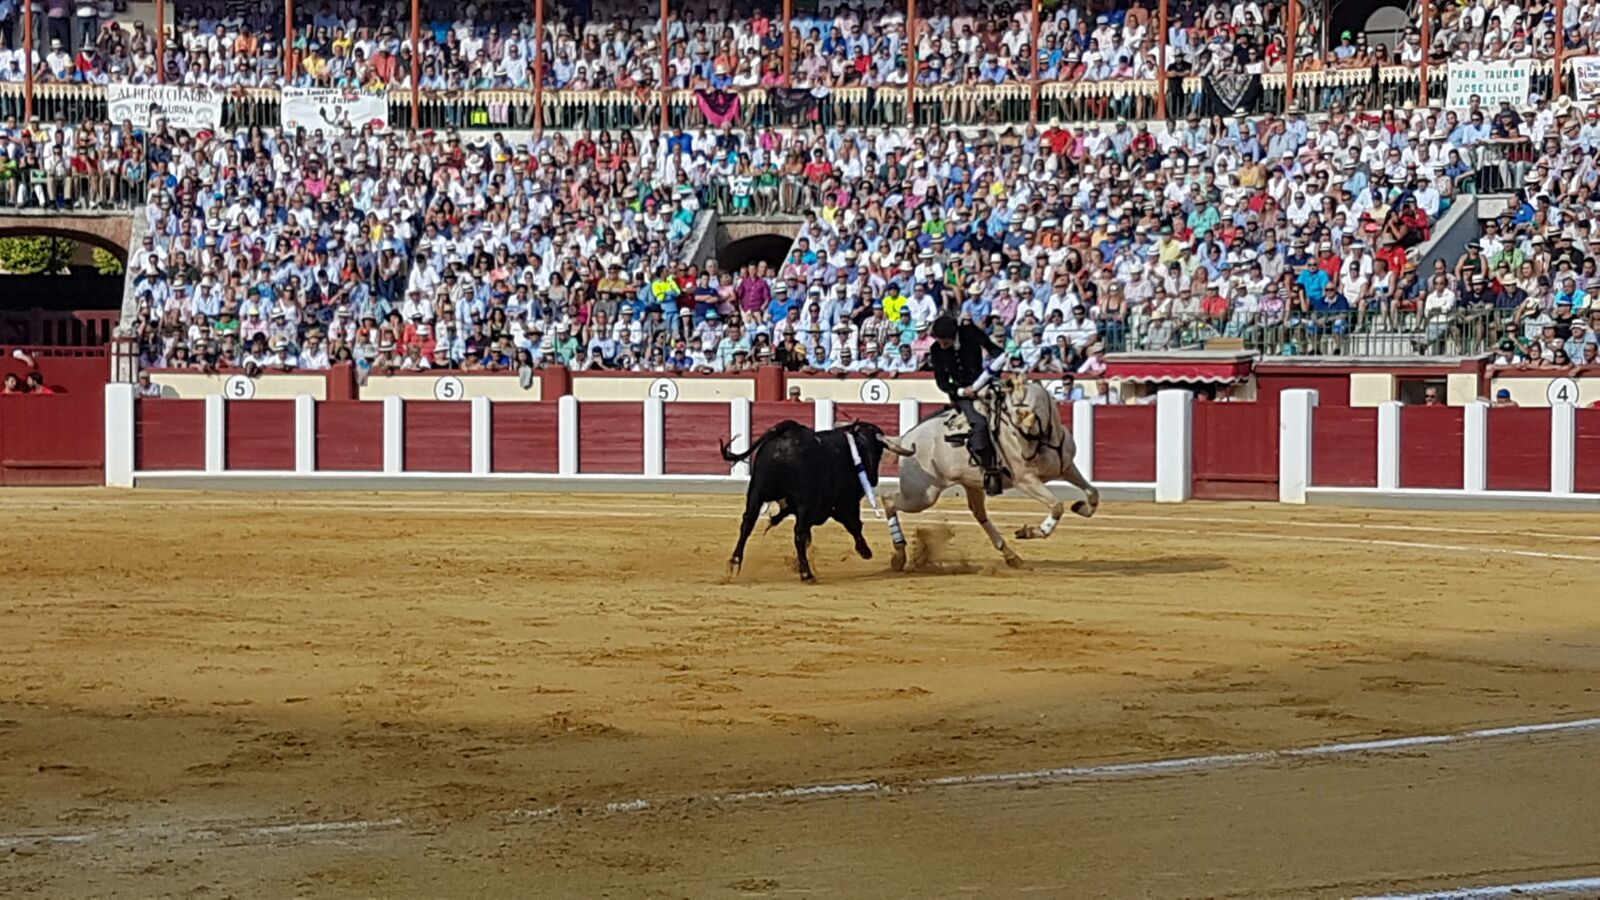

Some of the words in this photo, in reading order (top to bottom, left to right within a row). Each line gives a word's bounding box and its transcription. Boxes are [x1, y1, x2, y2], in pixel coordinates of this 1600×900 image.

[1456, 83, 1519, 93] JOSELILLO
[234, 381, 245, 397] 5
[443, 382, 454, 398] 5
[659, 384, 669, 400] 5
[870, 385, 880, 401] 5
[1557, 385, 1569, 401] 4
